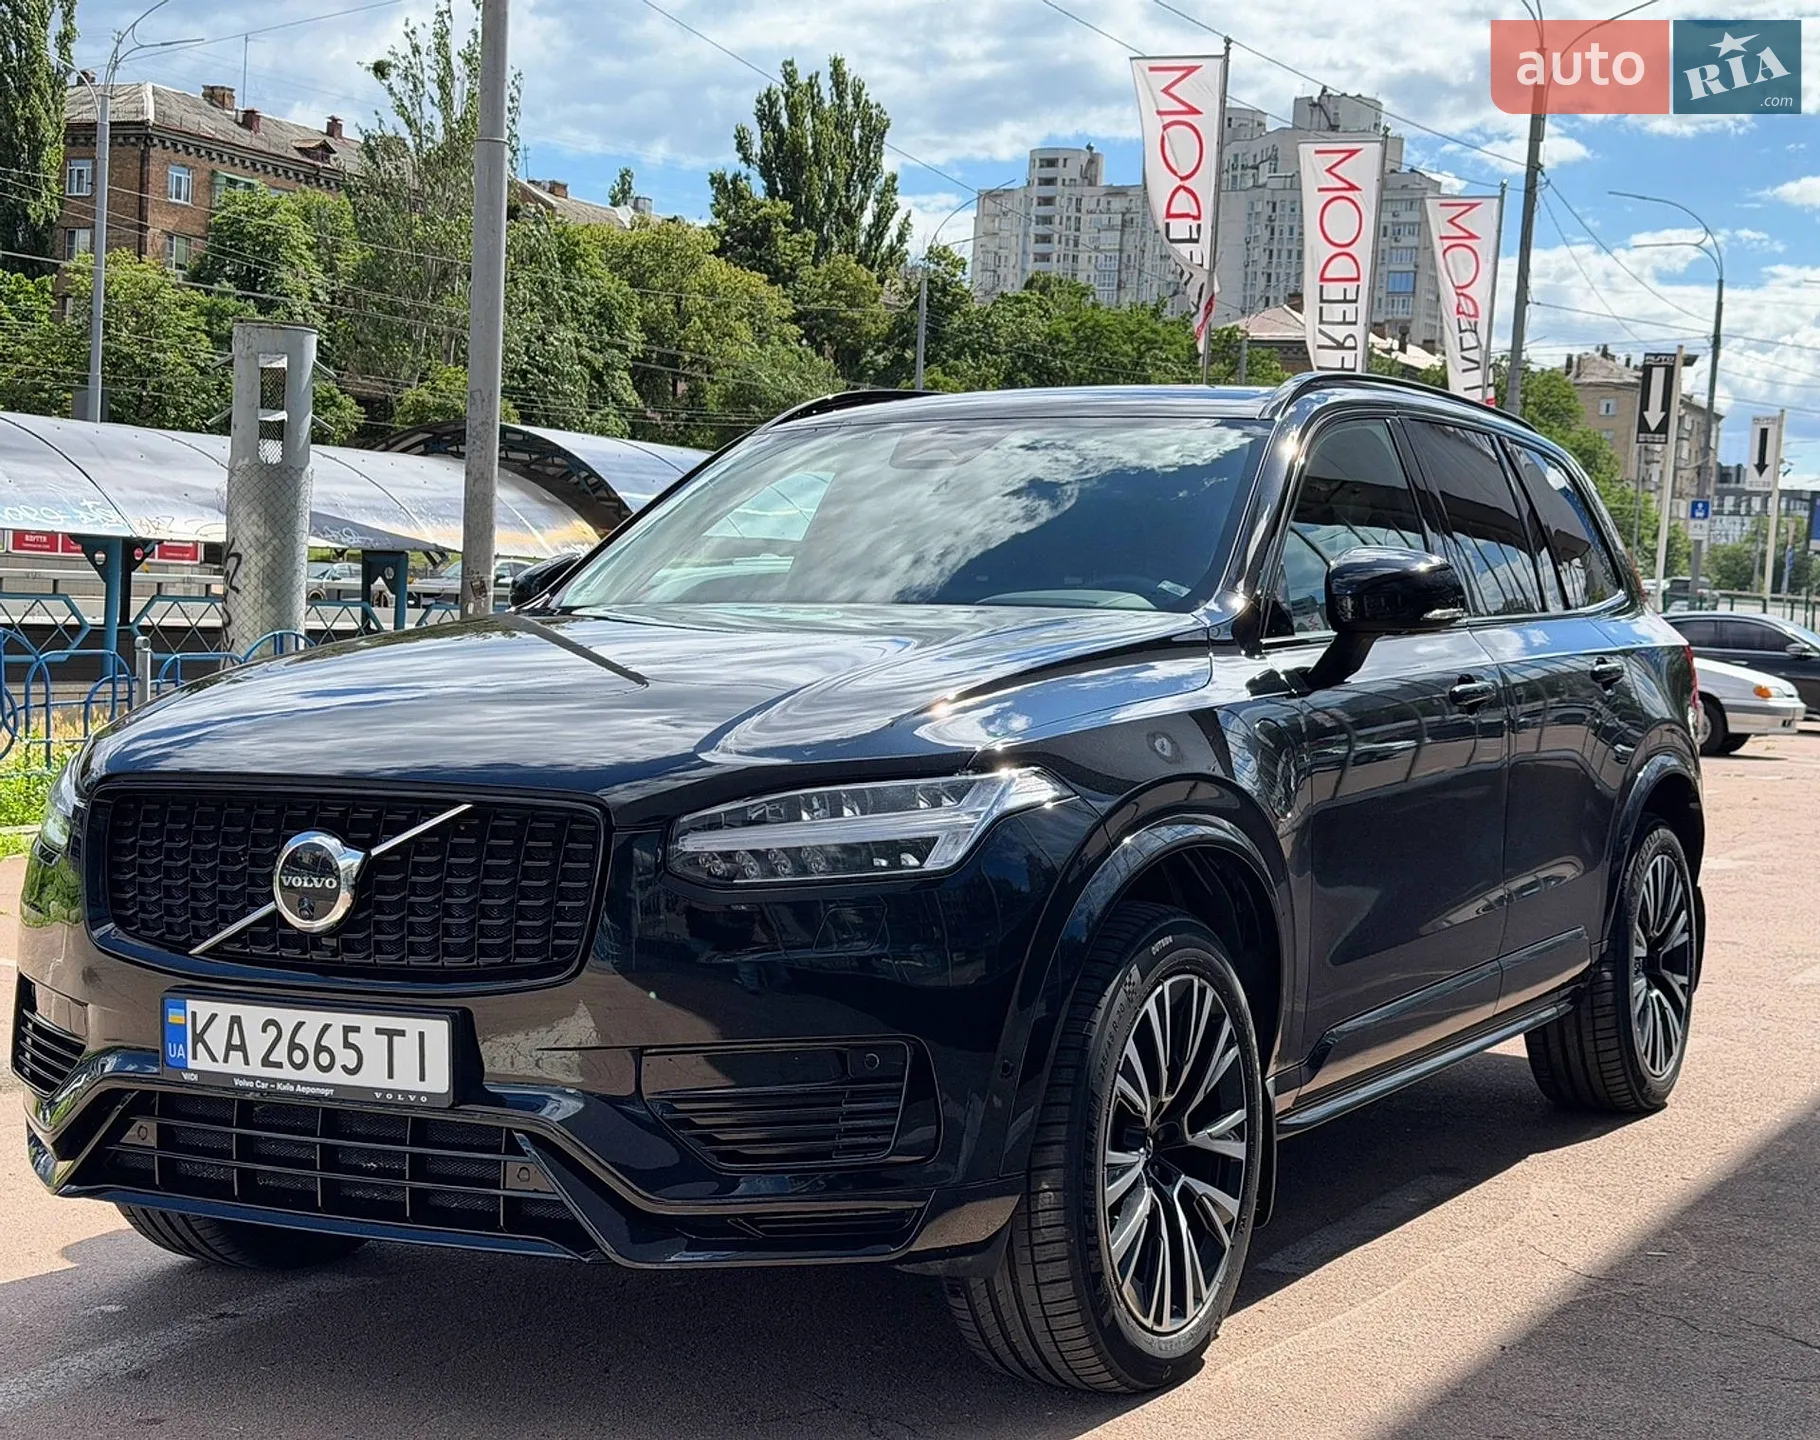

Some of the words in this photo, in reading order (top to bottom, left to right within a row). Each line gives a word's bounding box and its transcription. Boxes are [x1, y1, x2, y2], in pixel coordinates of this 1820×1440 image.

[280, 876, 337, 889] VOLVO
[168, 1043, 185, 1059] UA
[190, 1010, 250, 1067] KA
[260, 1018, 364, 1075] 2665
[375, 1027, 426, 1083] TI
[233, 1077, 254, 1087] Volvo
[255, 1080, 268, 1089] Car
[295, 1084, 334, 1096] Аеропорт
[374, 1091, 427, 1102] VOLVO
